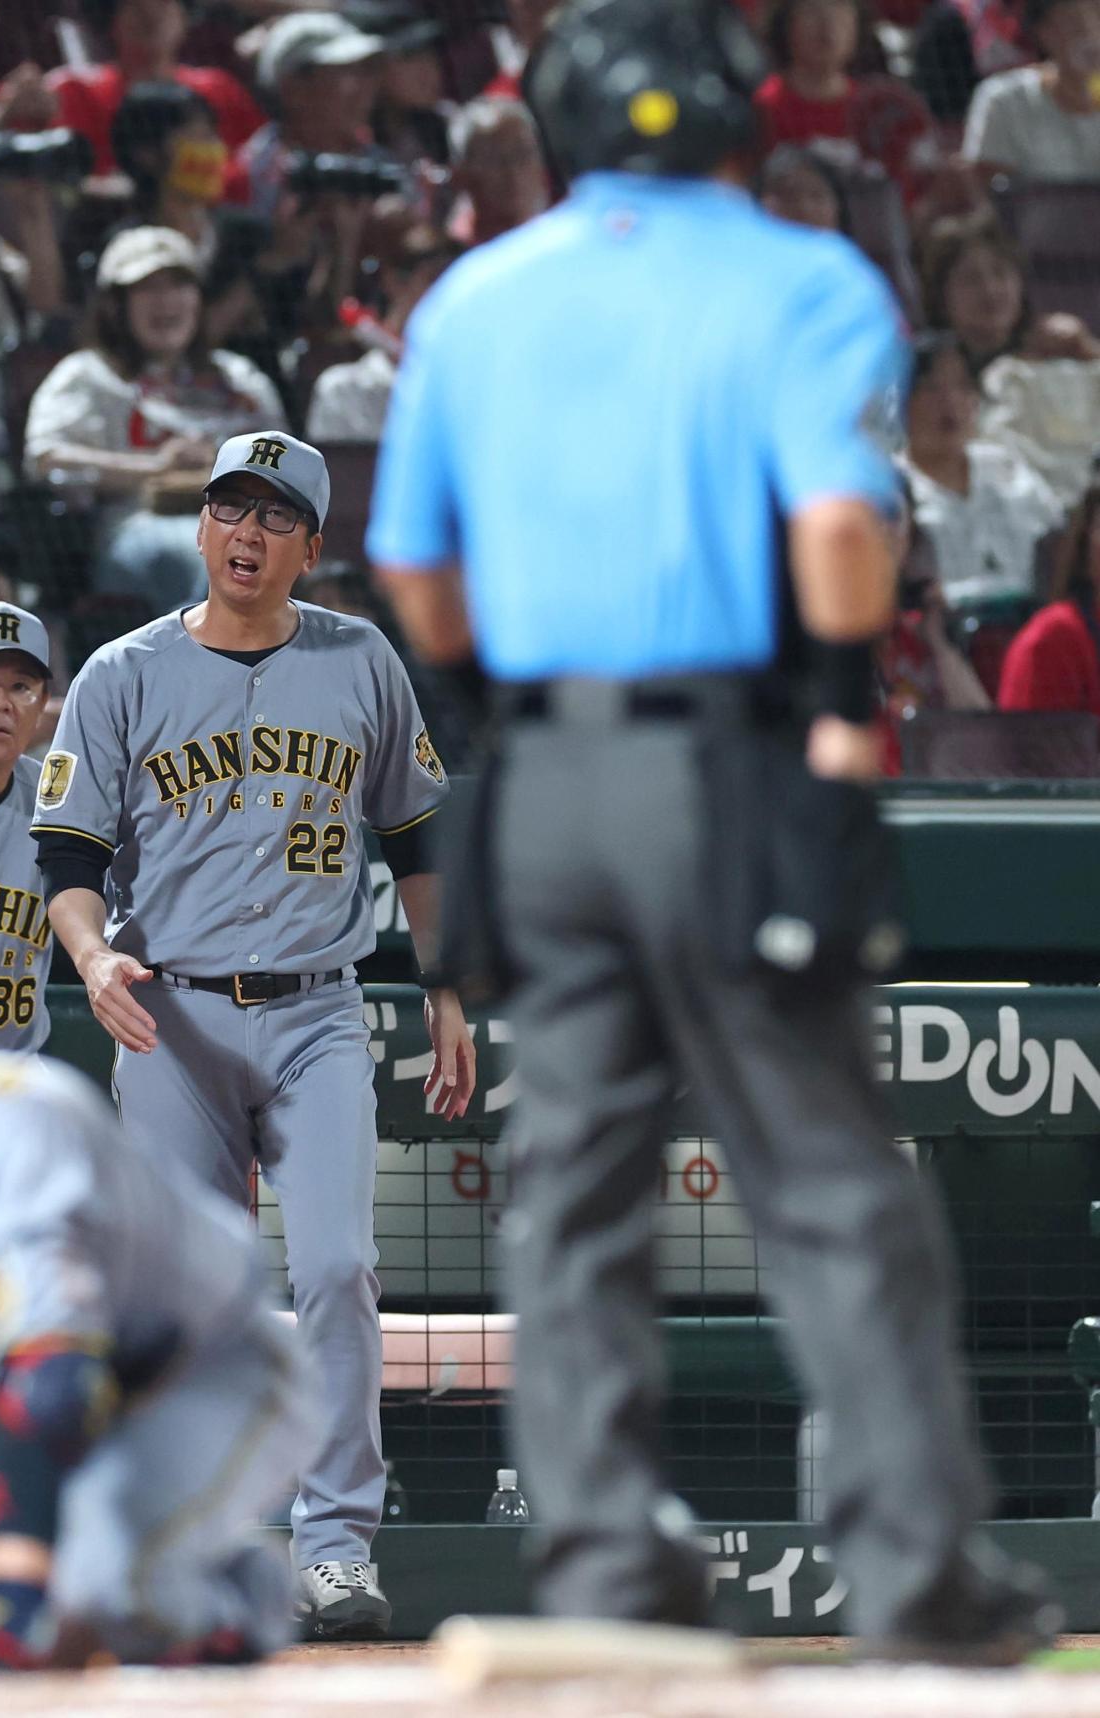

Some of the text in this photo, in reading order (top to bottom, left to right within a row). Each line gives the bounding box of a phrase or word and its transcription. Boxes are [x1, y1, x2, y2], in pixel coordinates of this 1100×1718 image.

[143, 725, 363, 802] HANSHIN
[175, 791, 342, 820] TIGERS
[286, 820, 348, 876] 22
